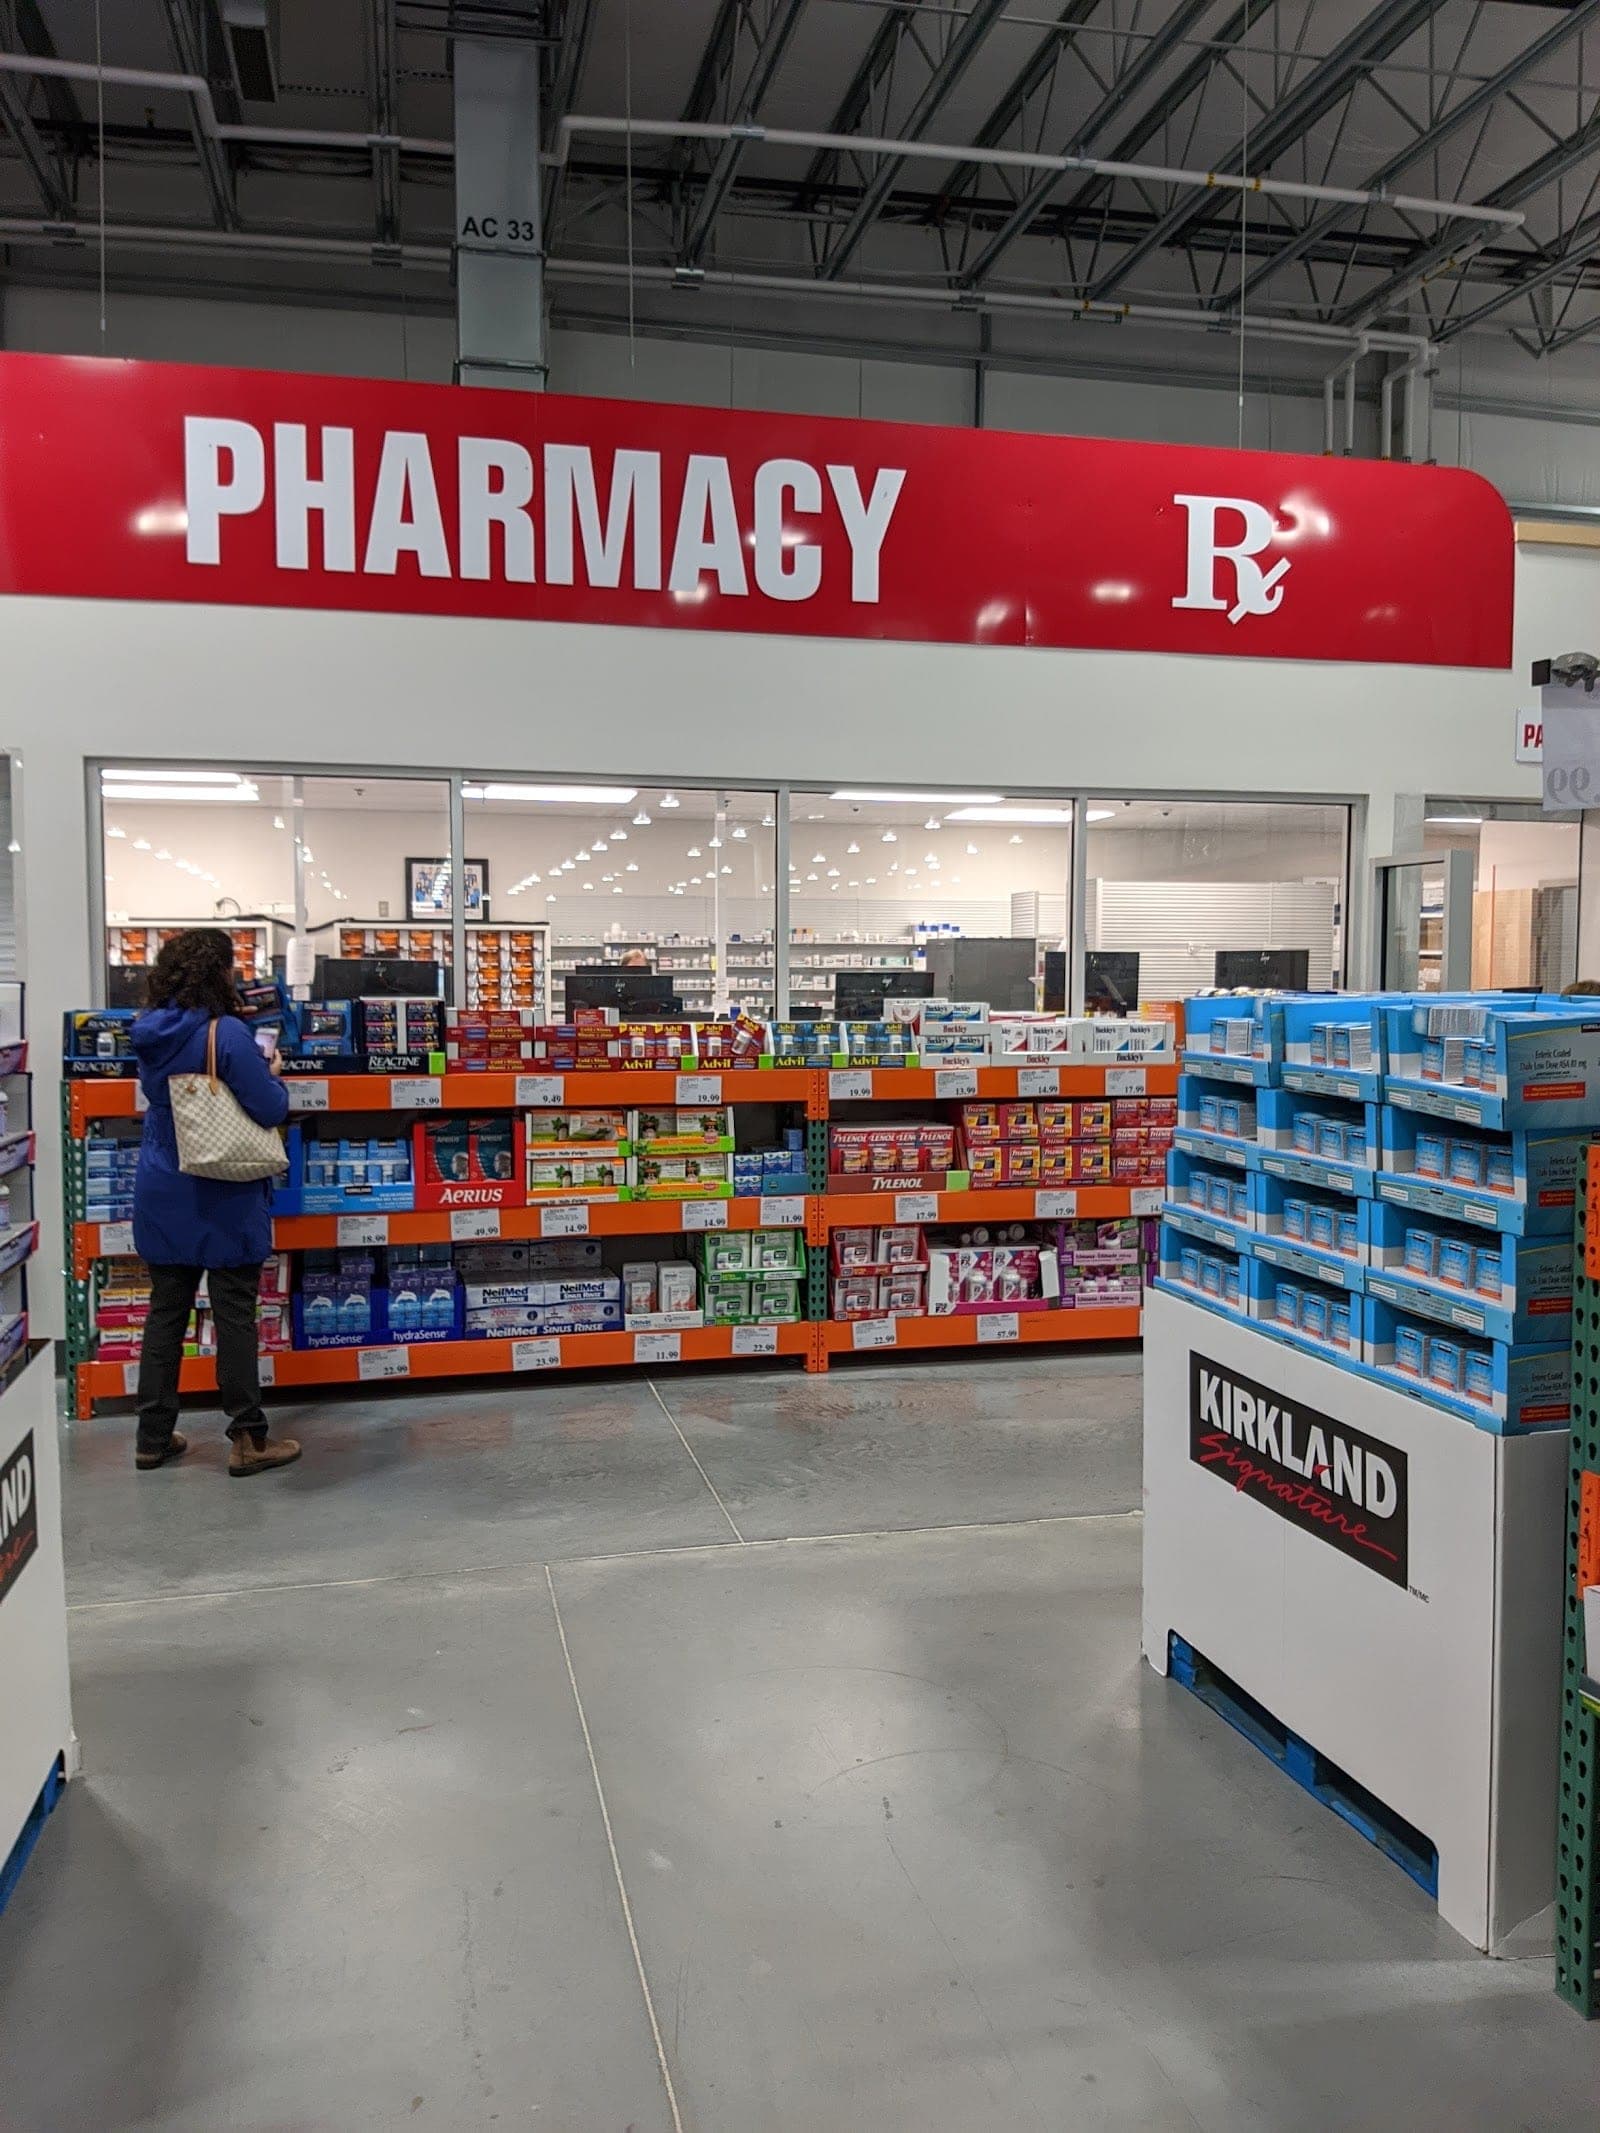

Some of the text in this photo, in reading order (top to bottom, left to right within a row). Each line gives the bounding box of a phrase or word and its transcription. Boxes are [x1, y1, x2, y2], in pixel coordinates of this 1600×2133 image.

[462, 216, 535, 242] AC 33
[184, 415, 907, 603] PHARMACY
[282, 1060, 326, 1070] EACTINE
[368, 1055, 420, 1067] REACTINE
[621, 1058, 653, 1070] Advil
[701, 1058, 731, 1069] Advil
[775, 1056, 805, 1067] Advil
[850, 1055, 878, 1065] Advil
[72, 1061, 125, 1073] REACTINE
[850, 1088, 871, 1097] 19.99
[1038, 1086, 1058, 1094] 14.99
[1125, 1086, 1144, 1094] 17.99
[871, 1177, 923, 1191] TYLENOL
[1055, 1207, 1075, 1216] 17.99
[704, 1218, 726, 1227] 14.99
[781, 1215, 802, 1223] 11.99
[475, 1226, 498, 1236] 49.99
[565, 1224, 587, 1233] 14.99
[483, 1287, 529, 1296] NeilMed
[560, 1283, 605, 1292] NeilMed
[392, 1329, 447, 1343] hydraSense
[486, 1326, 537, 1338] NeilMed
[542, 1324, 572, 1334] SINUS
[308, 1335, 363, 1347] hydraSense
[656, 1351, 678, 1360] 11.99
[1199, 1368, 1398, 1519] KIRKLAND
[1199, 1433, 1398, 1562] Signature
